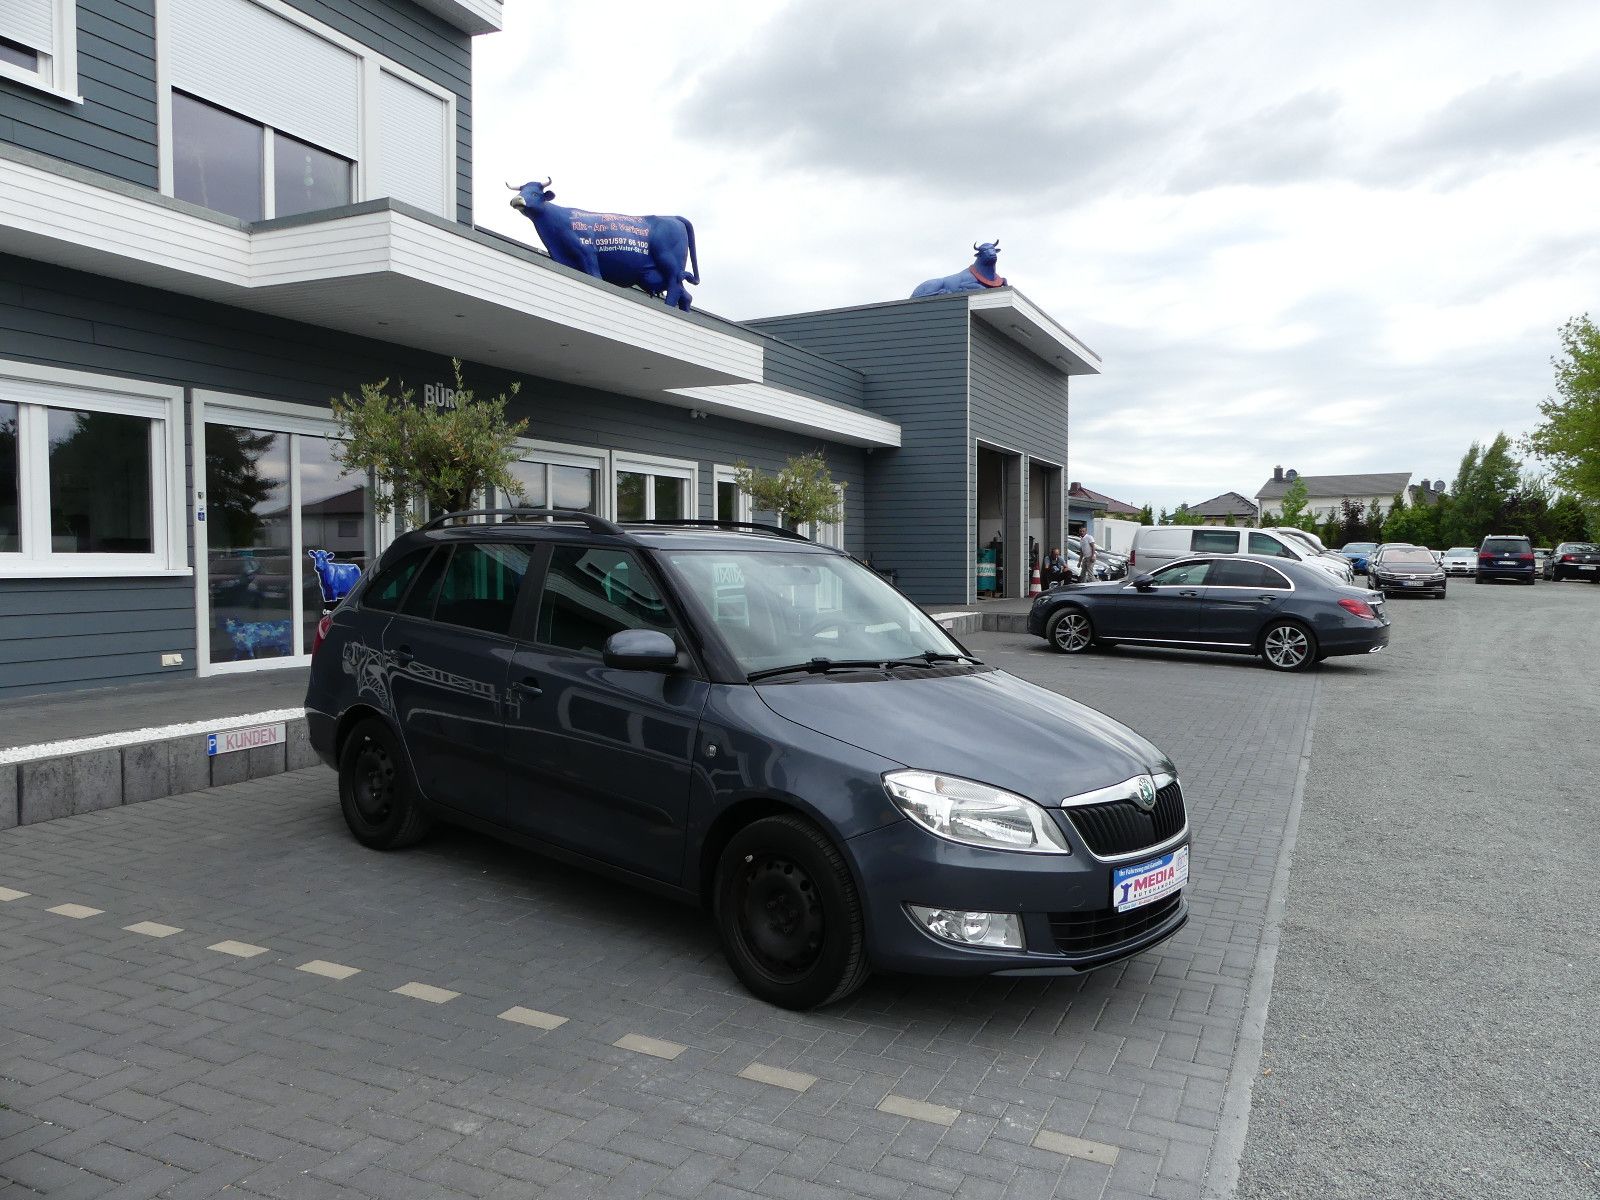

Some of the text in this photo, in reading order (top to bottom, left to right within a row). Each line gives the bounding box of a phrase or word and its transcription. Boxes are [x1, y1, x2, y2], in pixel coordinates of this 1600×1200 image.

[596, 238, 627, 246] 0391/597
[637, 240, 648, 249] 100
[209, 728, 276, 751] P KUNDEN
[1134, 867, 1174, 892] MEDIA
[1134, 881, 1174, 898] AUTOHANDEL
